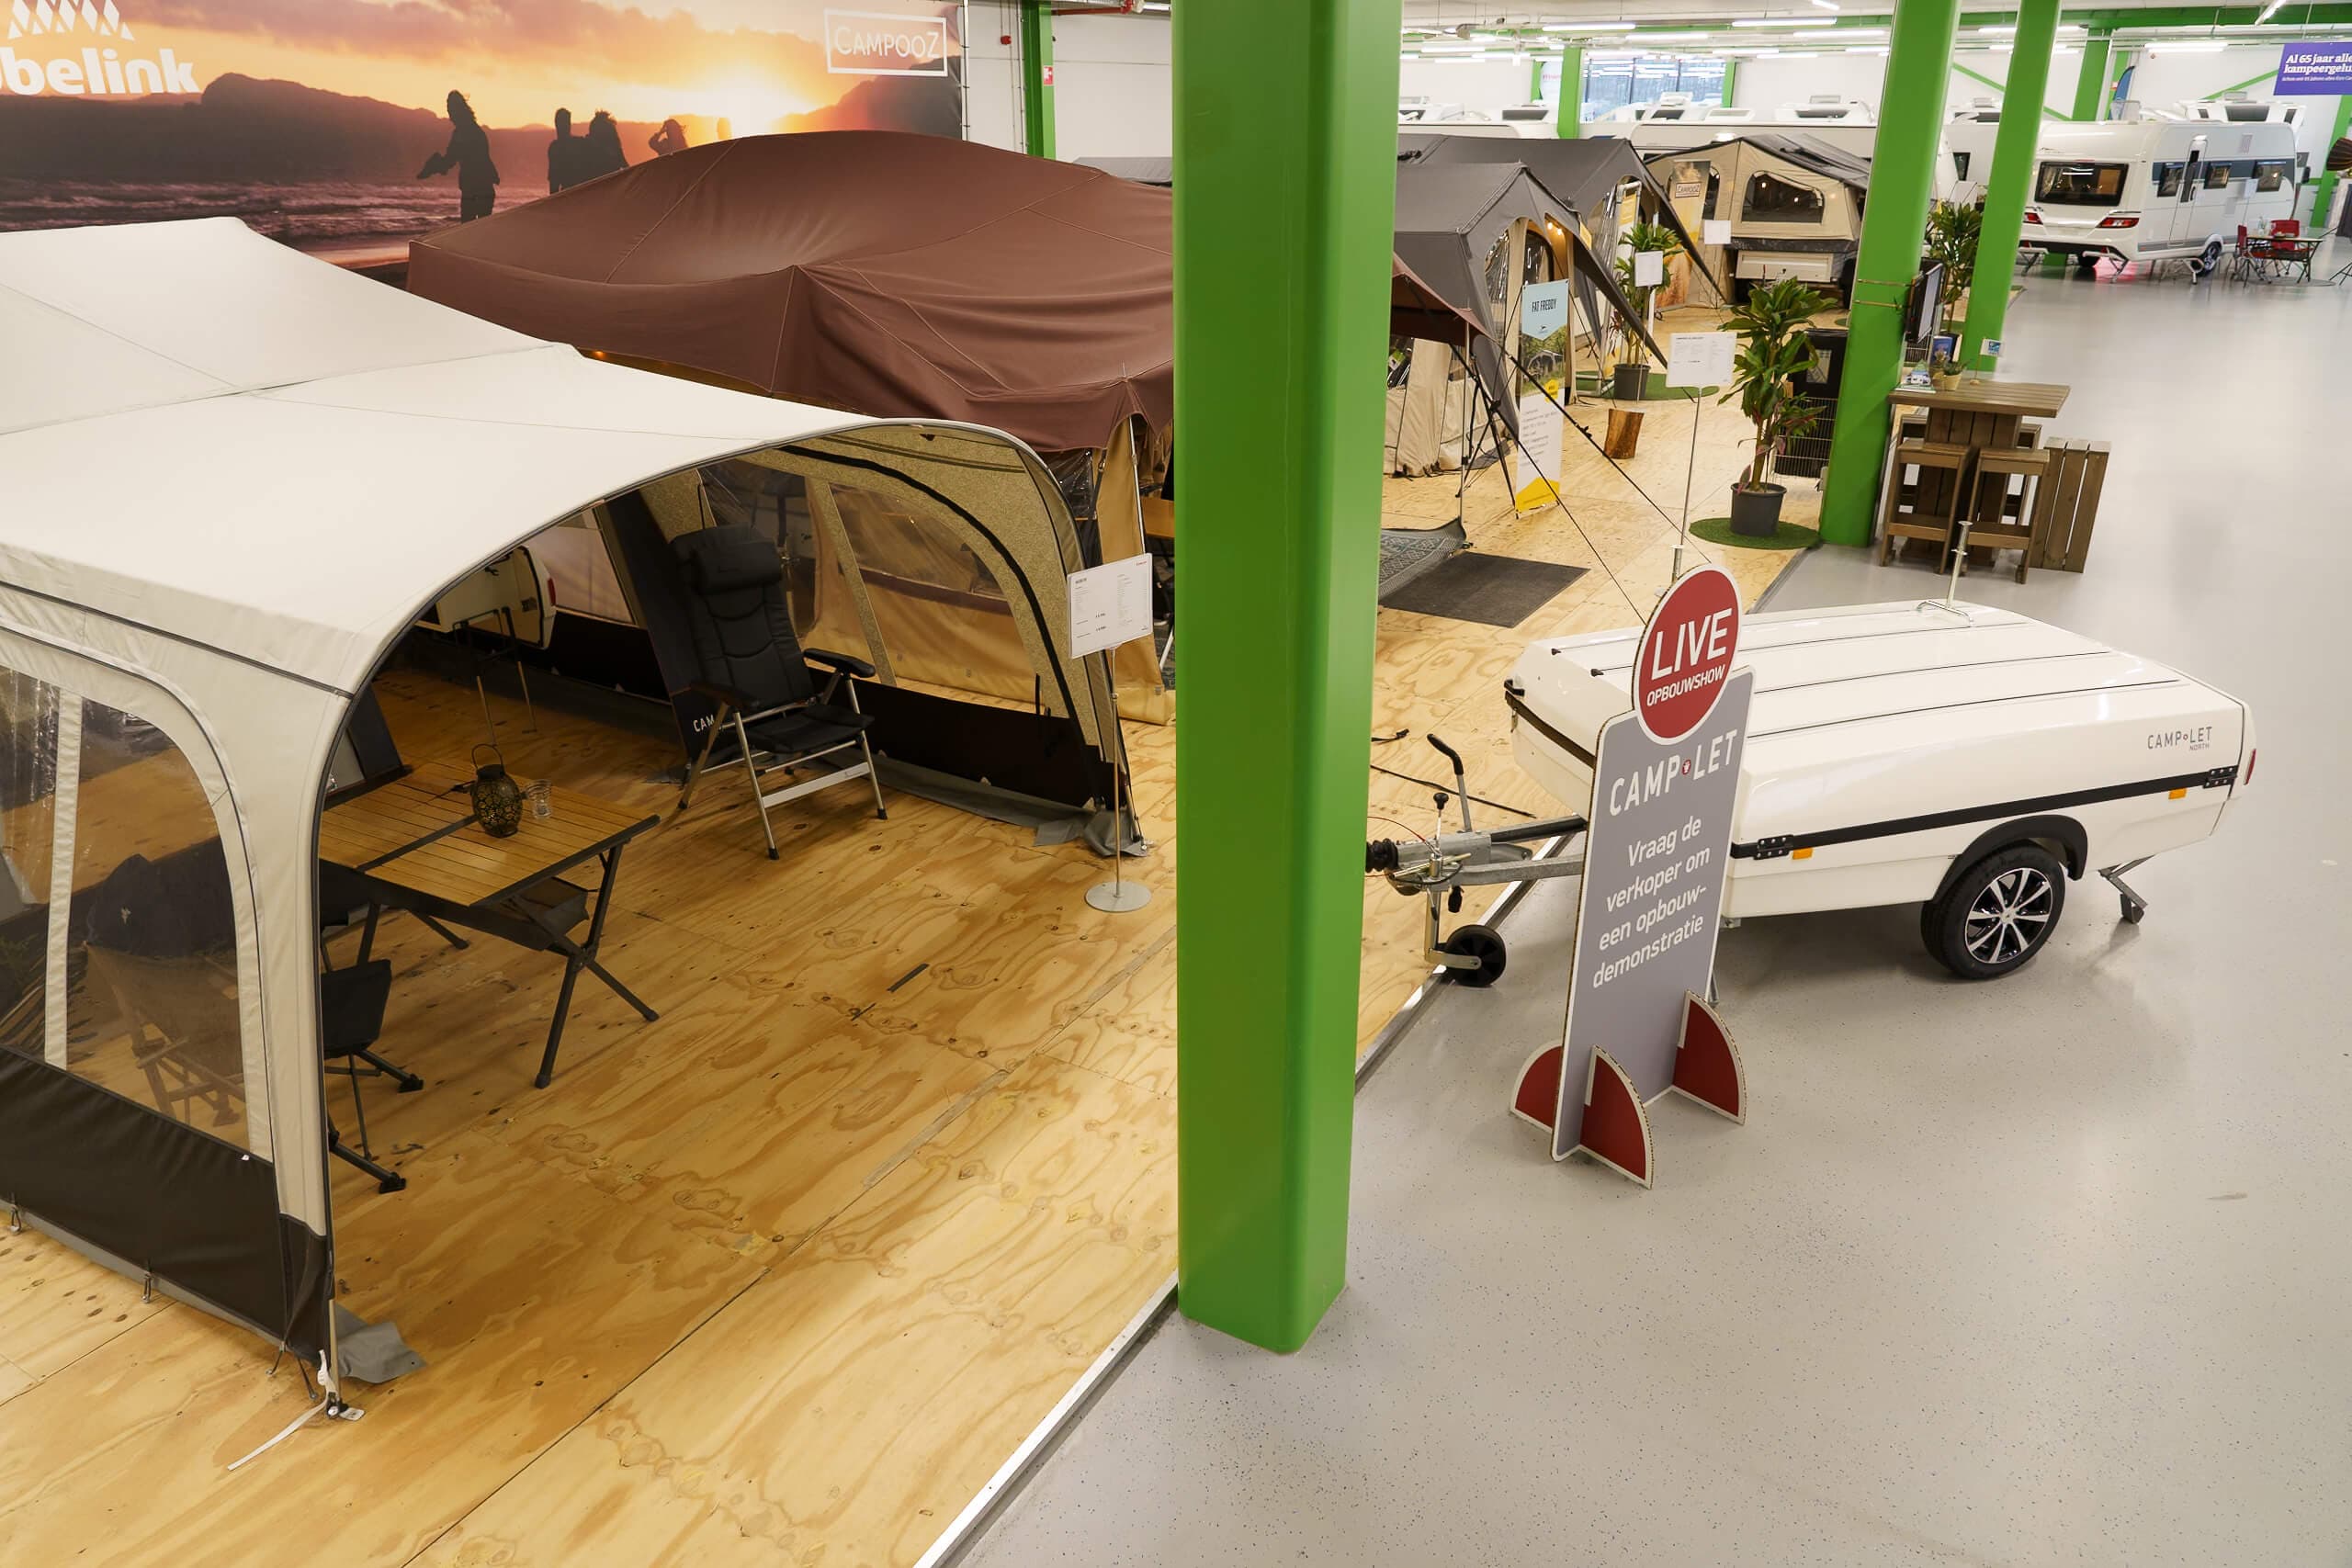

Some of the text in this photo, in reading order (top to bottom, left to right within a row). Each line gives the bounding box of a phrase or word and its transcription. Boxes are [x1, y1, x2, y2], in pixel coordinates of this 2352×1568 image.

[835, 27, 940, 58] CAMPOOZ
[2286, 54, 2298, 63] Al
[2311, 53, 2335, 65] jaar
[0, 47, 201, 96] belink
[1651, 608, 1733, 681] LIVE
[1646, 664, 1726, 706] OPBOUWSHOW
[693, 714, 715, 732] CAM
[1628, 815, 1702, 867] Vraag de
[1606, 847, 1711, 912] verkoper om
[1600, 886, 1707, 951] een opbouw-
[1593, 915, 1704, 988] demonstratie
